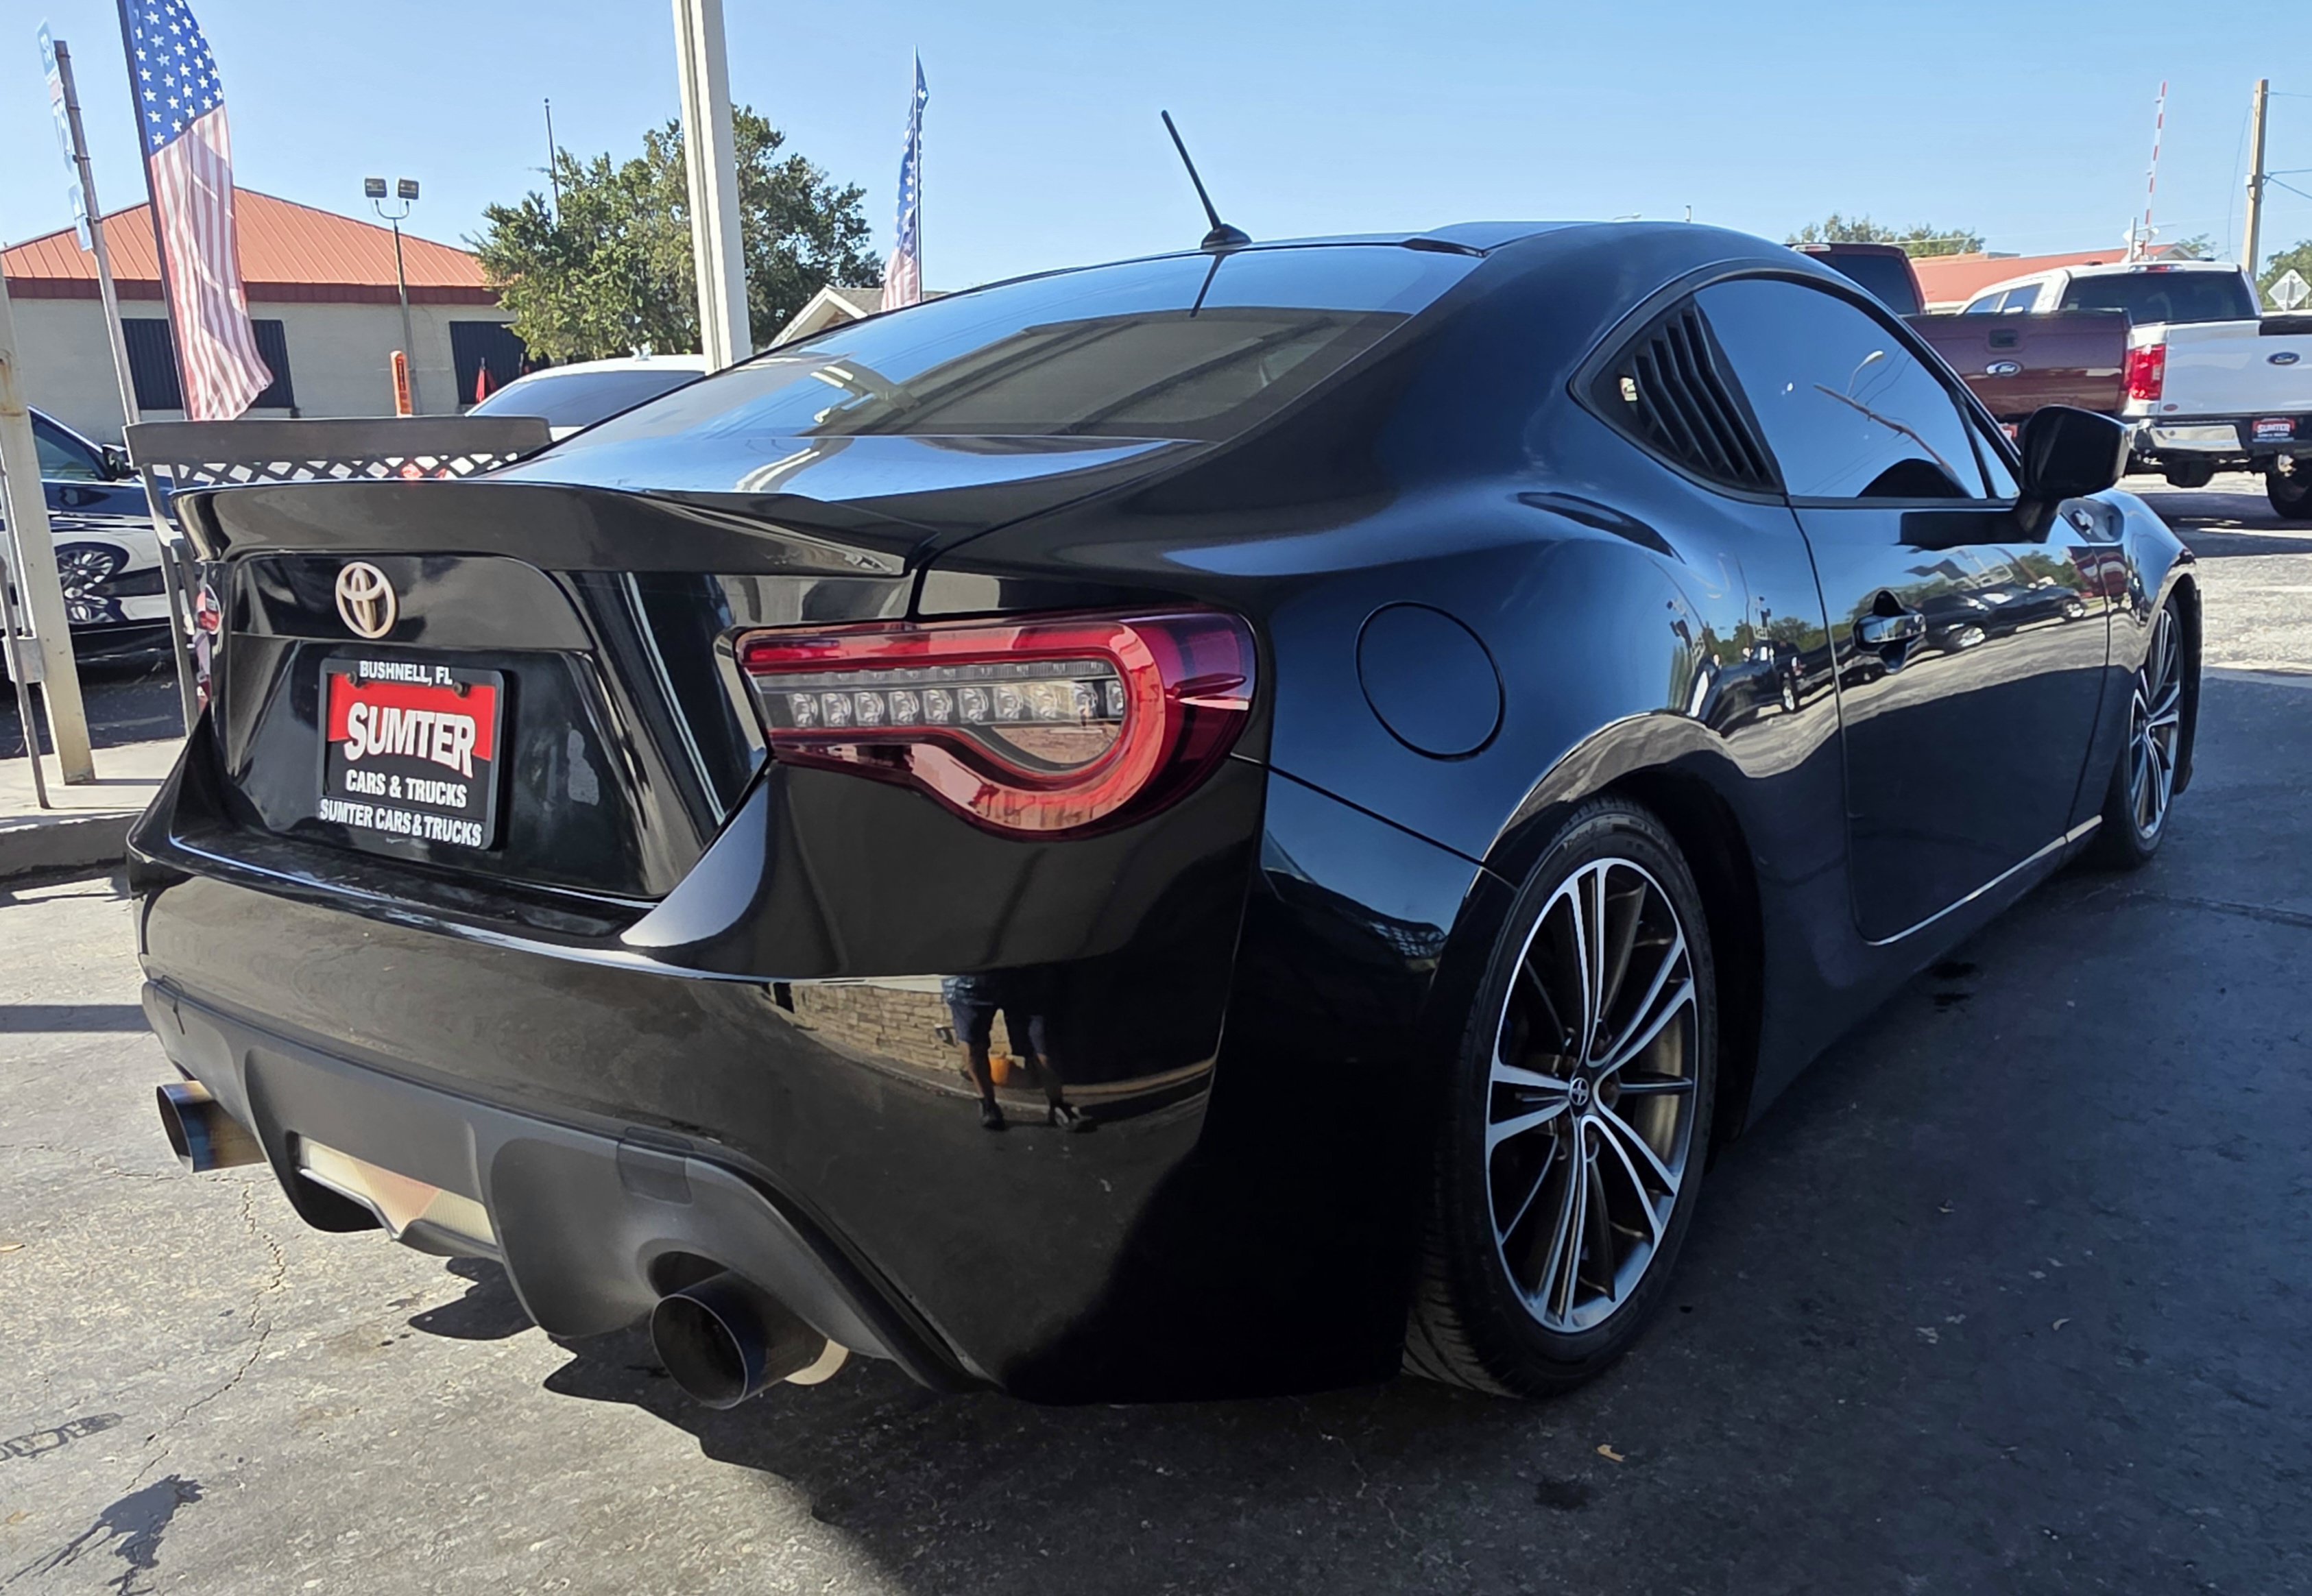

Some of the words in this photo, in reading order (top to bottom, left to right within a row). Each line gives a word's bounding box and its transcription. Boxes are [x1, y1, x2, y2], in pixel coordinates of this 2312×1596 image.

[359, 660, 433, 686] BUSHNELL,
[436, 666, 453, 685] FL
[344, 702, 476, 778] SUMTER
[346, 769, 386, 795] CARS
[389, 775, 402, 799] &
[405, 777, 468, 808] TRUCKS
[320, 799, 374, 827] SUMTER
[375, 808, 411, 834] CARS
[412, 814, 422, 836] &
[423, 816, 482, 847] TRUCKS
